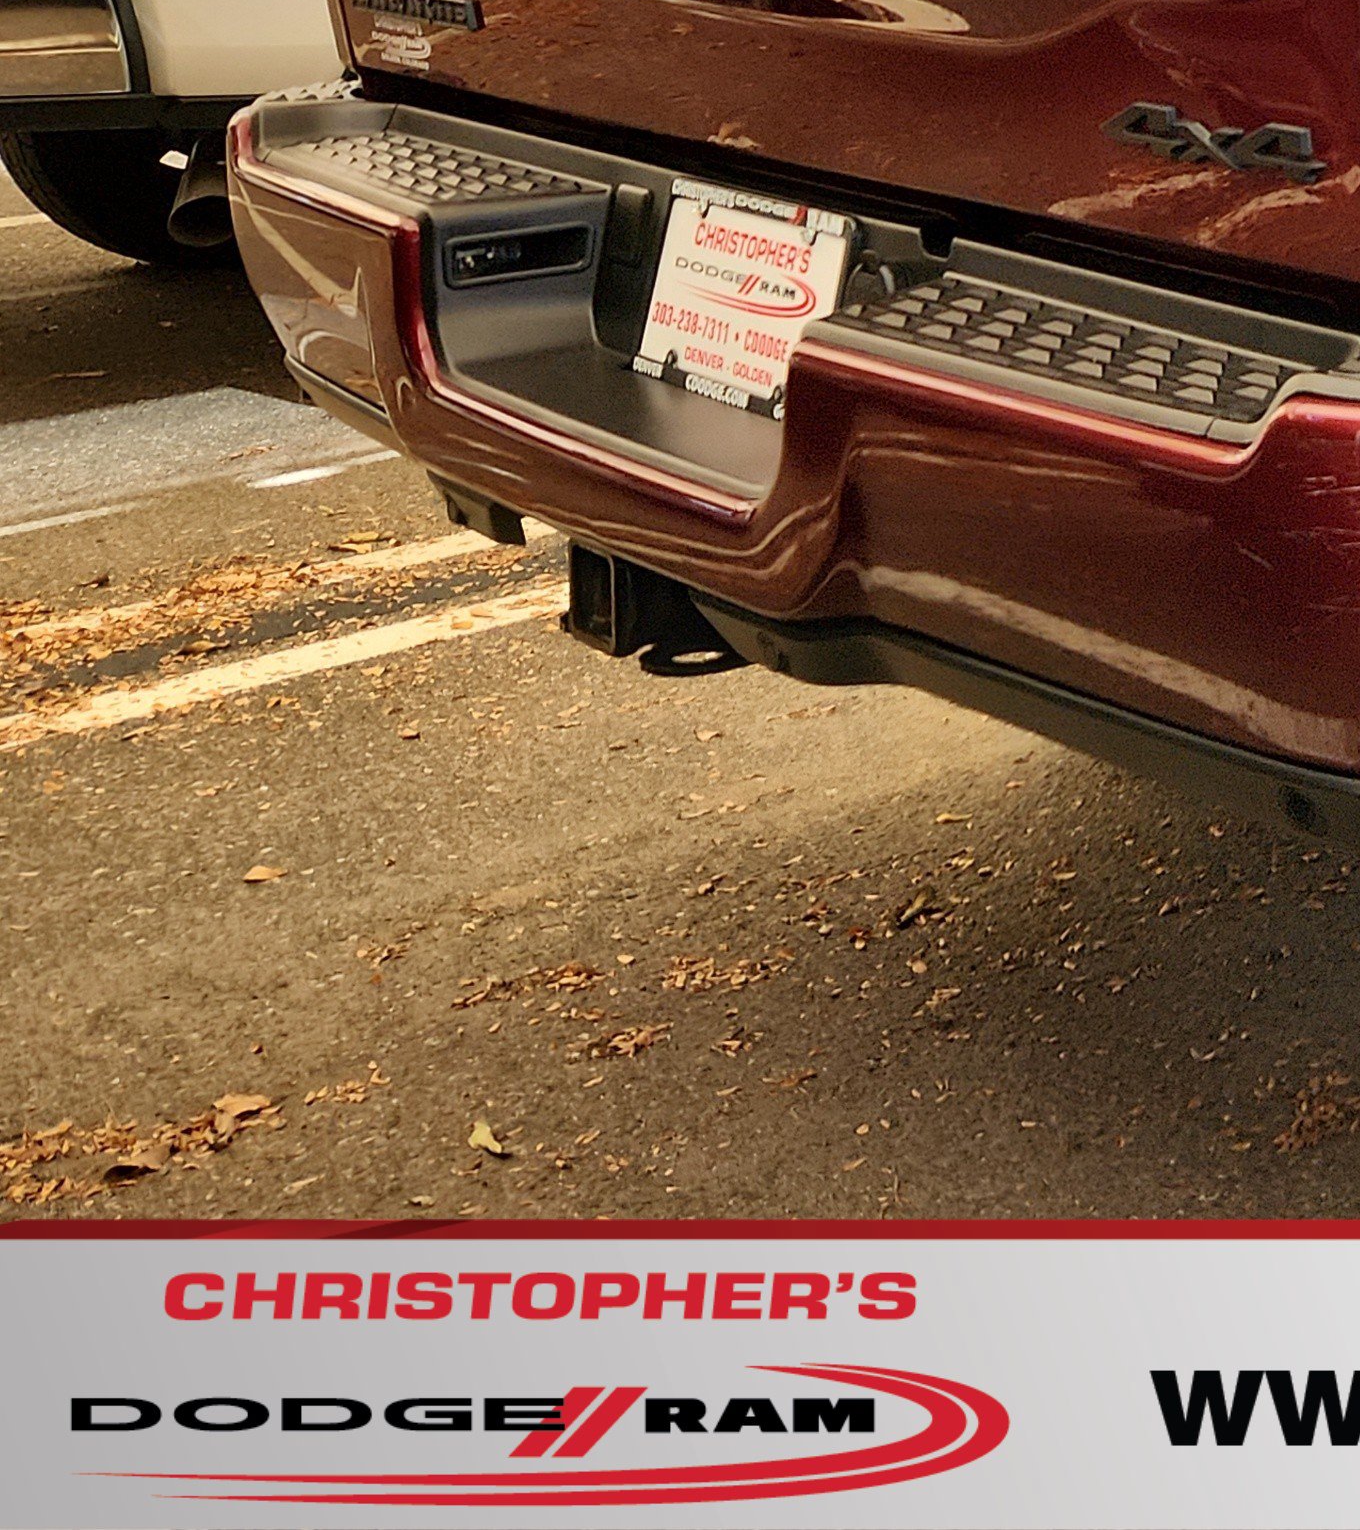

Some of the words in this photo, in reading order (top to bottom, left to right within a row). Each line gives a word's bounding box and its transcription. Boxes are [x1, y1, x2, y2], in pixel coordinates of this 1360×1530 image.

[694, 221, 812, 274] CHRISTOPHER'S
[675, 256, 746, 287] DODGE
[759, 280, 797, 301] RAM
[651, 300, 731, 345] 303-238-7311
[684, 345, 724, 371] DENVER
[732, 361, 774, 388] GOLDEN
